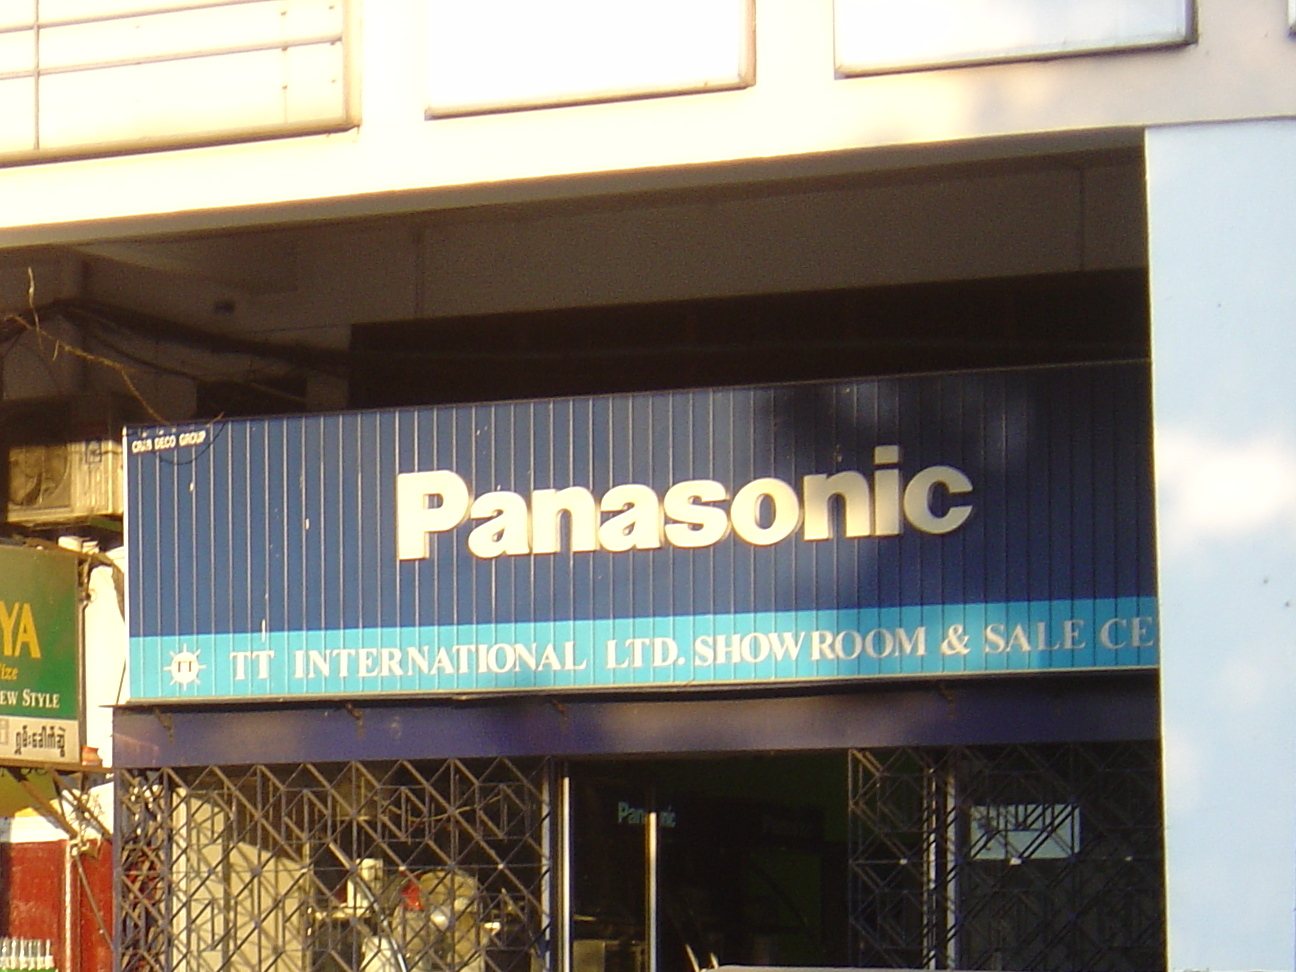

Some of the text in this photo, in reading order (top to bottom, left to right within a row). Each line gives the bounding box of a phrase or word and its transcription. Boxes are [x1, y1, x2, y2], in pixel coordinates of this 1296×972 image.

[398, 444, 974, 560] Panasonic
[229, 650, 274, 681] TT
[294, 641, 587, 679] INTERNATIONAL
[605, 636, 685, 669] LTD.
[940, 623, 971, 656] &
[984, 619, 1087, 655] SALE
[22, 688, 60, 708] STYLE
